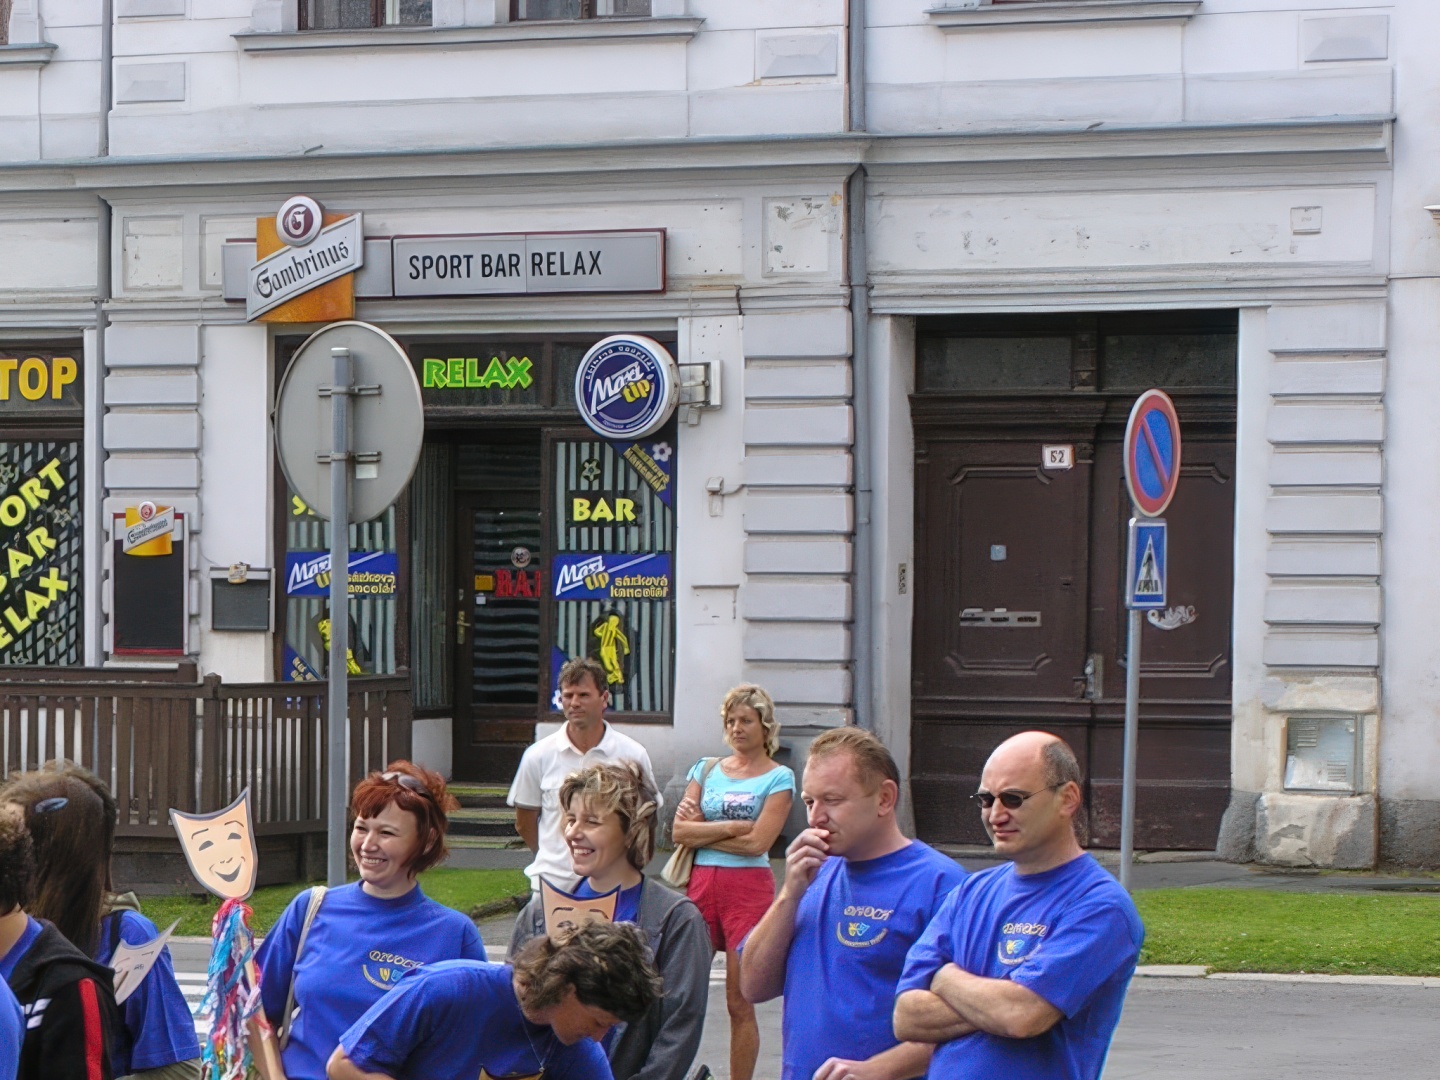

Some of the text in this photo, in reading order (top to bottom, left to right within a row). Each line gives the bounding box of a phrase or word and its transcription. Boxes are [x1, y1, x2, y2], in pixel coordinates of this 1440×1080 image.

[257, 241, 349, 298] Gambrinus
[409, 250, 602, 280] SPORT BAR RELAX
[423, 356, 534, 389] RELAX
[573, 497, 636, 522] BAR
